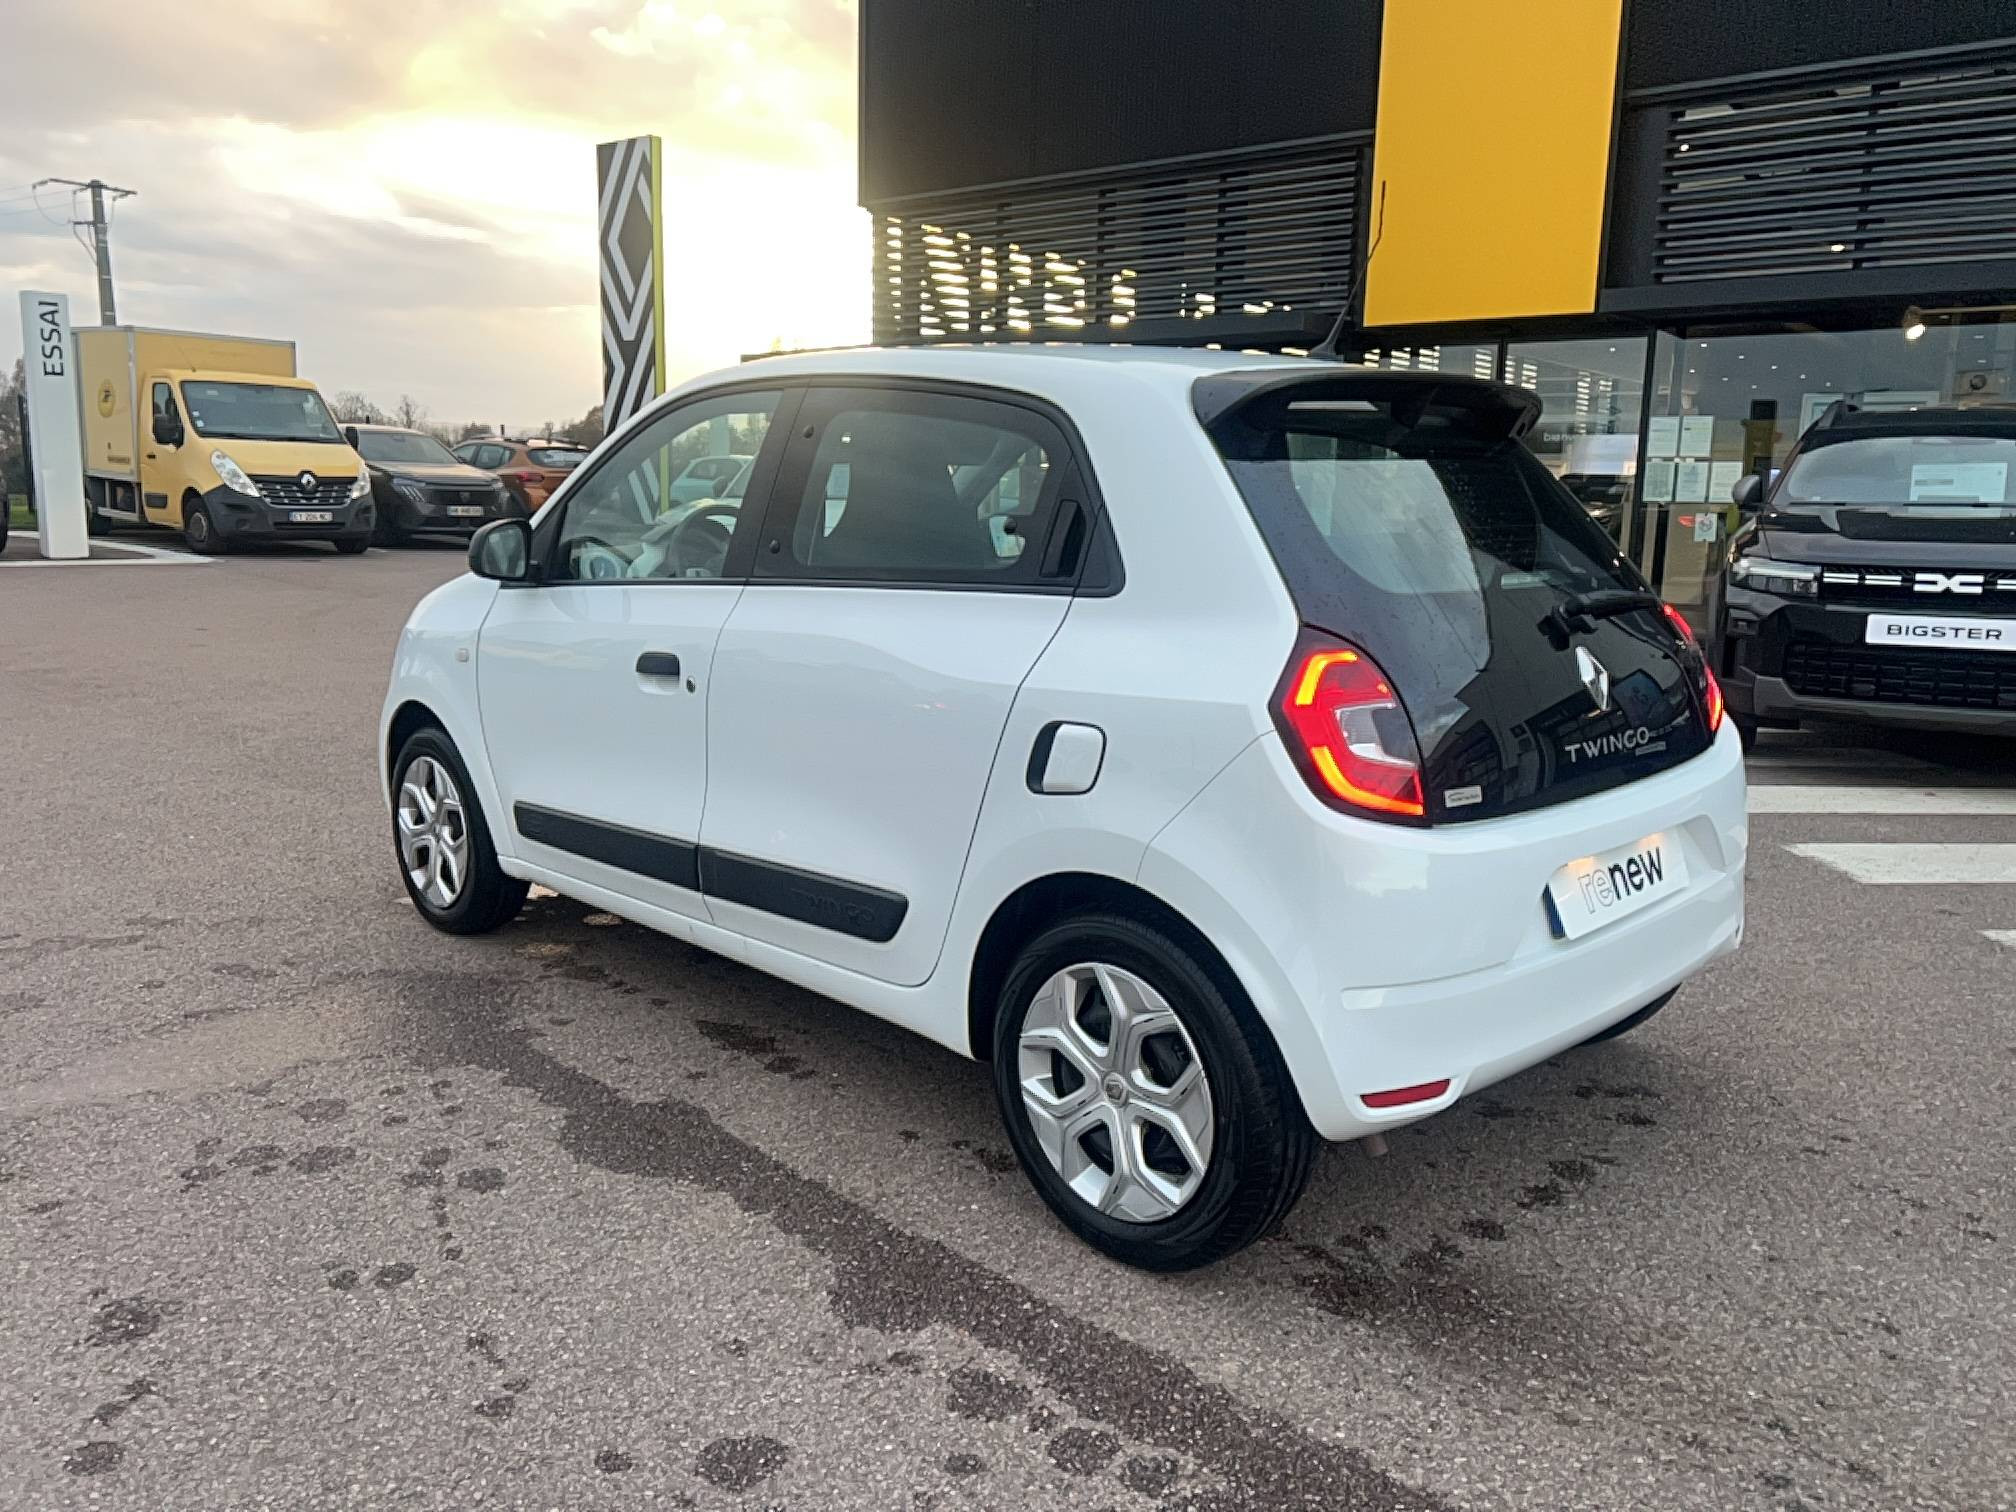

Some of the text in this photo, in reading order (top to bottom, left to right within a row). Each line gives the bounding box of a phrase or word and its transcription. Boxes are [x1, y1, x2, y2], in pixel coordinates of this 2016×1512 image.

[38, 300, 64, 376] ESSAI
[1886, 624, 2003, 641] BIGSTER
[1564, 726, 1650, 763] TWINGO
[1577, 846, 1664, 915] renew
